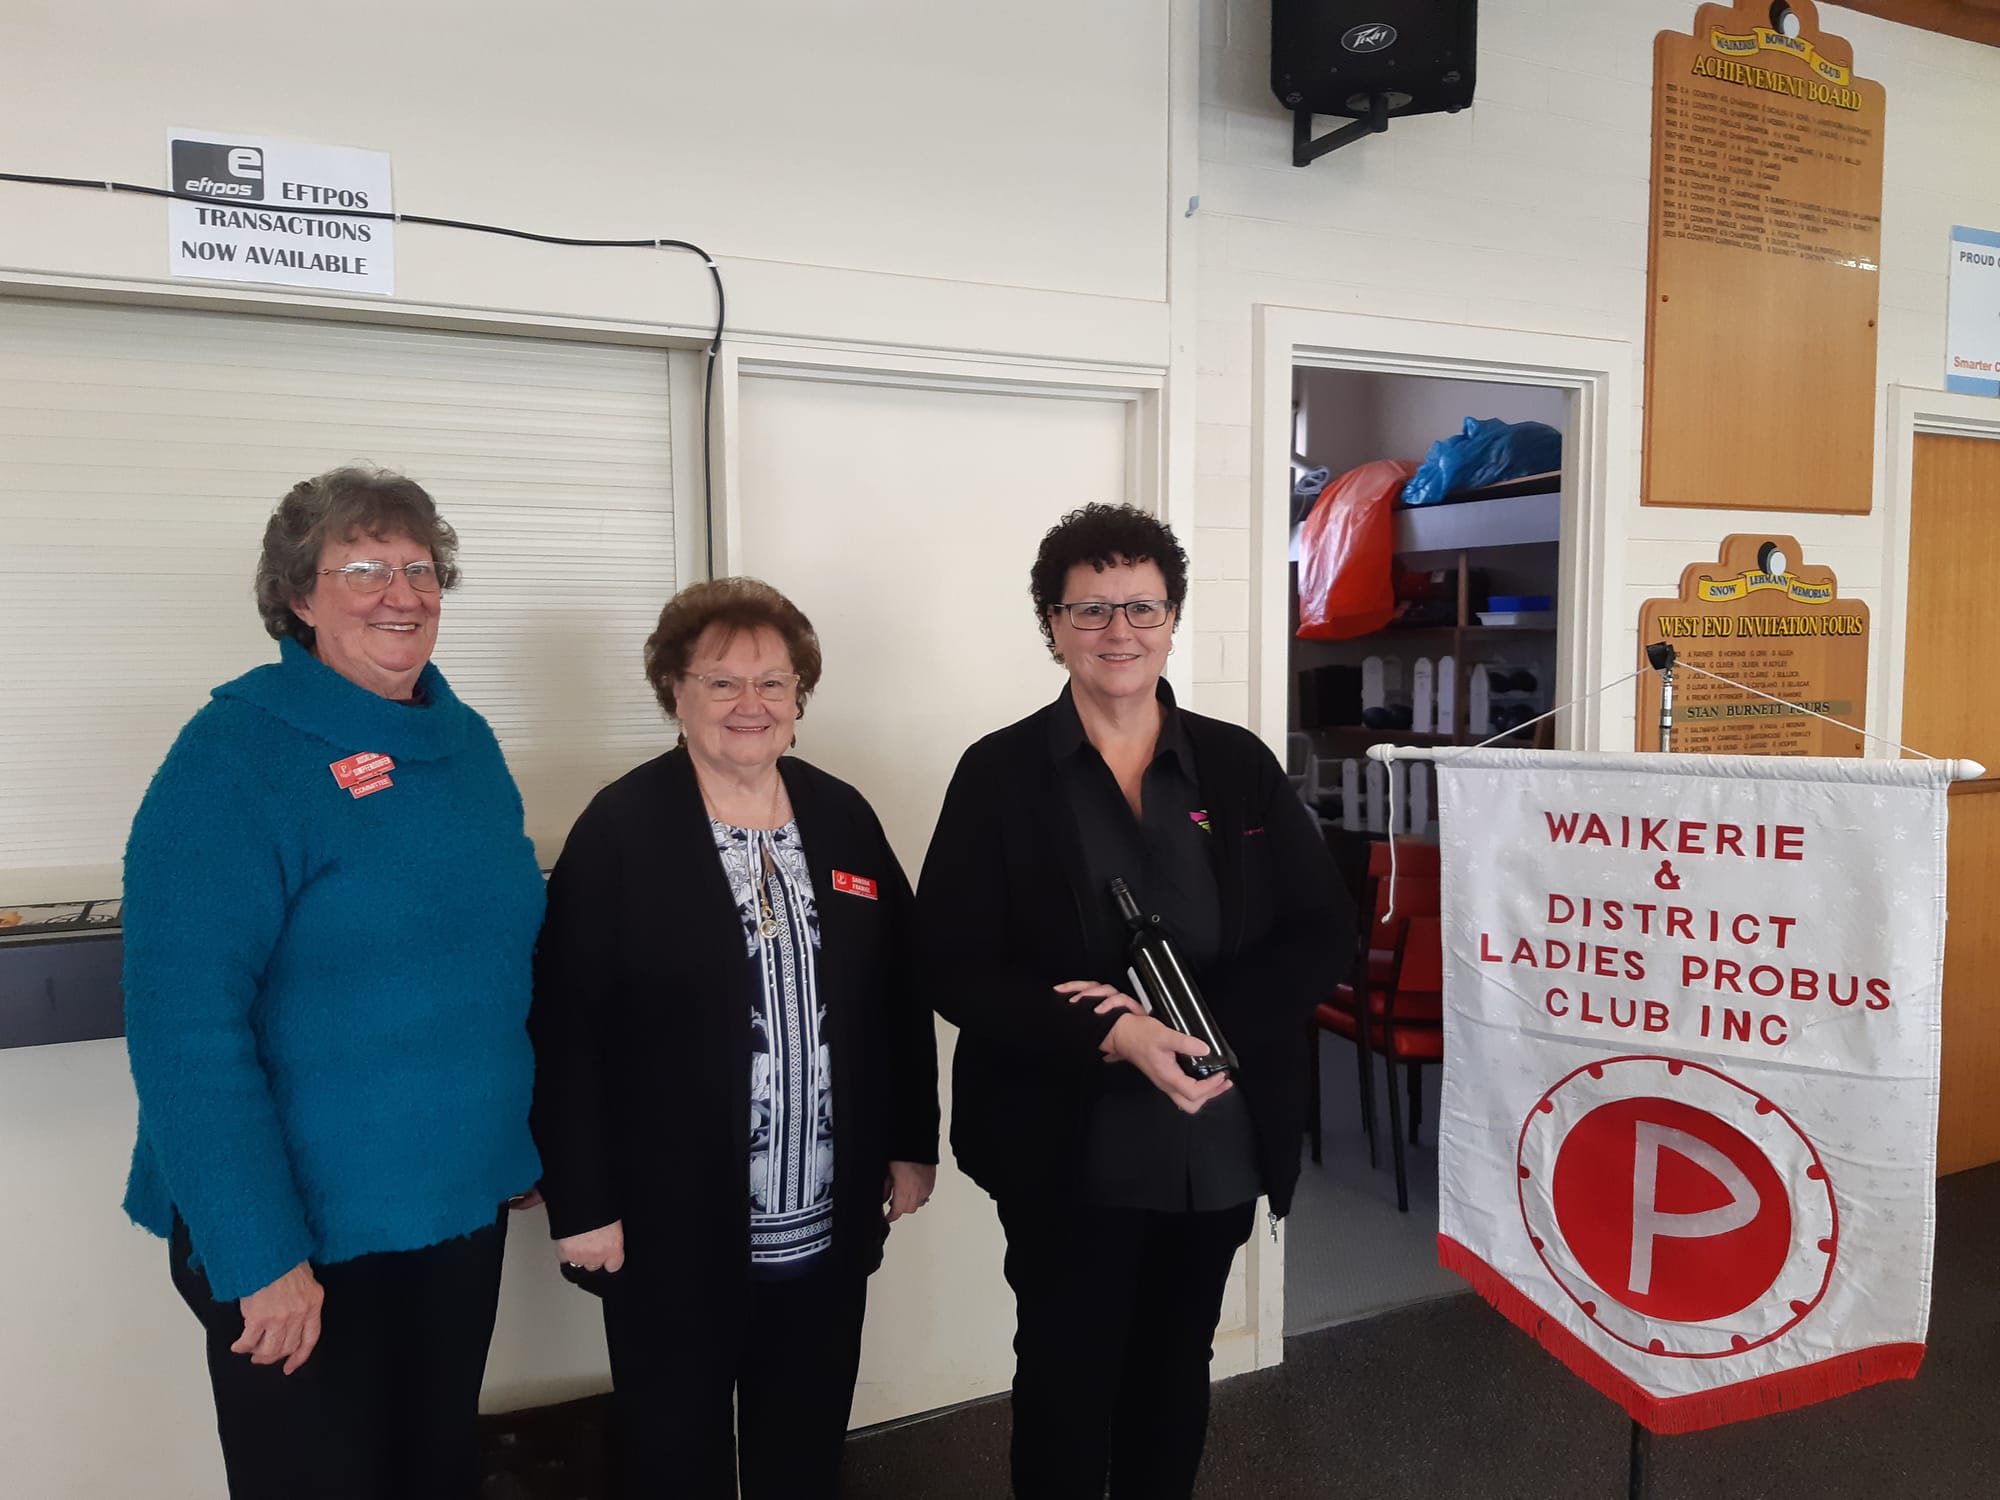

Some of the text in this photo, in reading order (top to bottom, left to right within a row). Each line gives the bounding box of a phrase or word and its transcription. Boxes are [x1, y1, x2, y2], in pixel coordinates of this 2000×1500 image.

[1765, 33, 1806, 51] BOWLING
[1818, 61, 1841, 79] CLUB
[1692, 55, 1863, 111] ACHIEVEMENT BOARD
[185, 177, 253, 196] eftpos
[282, 182, 369, 208] EFTPOS
[195, 207, 372, 243] TRANSACTIONS
[181, 241, 369, 276] NOW AVAILABLE
[1960, 251, 1995, 267] PROUD
[1953, 356, 1992, 372] Smarter
[1709, 574, 1831, 598] SNOW LEHMANN MEMORIAL
[1658, 615, 1864, 637] WEST END INVITATION FOURS
[1687, 701, 1830, 719] STAN BURNETT FOURS
[1545, 810, 1805, 861] WAIKERIE
[1653, 859, 1681, 890] &
[1547, 893, 1797, 949] DISTRICT
[1480, 933, 1891, 1011] LADIES PROBUS
[1545, 987, 1788, 1046] CLUB INC
[1627, 1119, 1761, 1296] P
